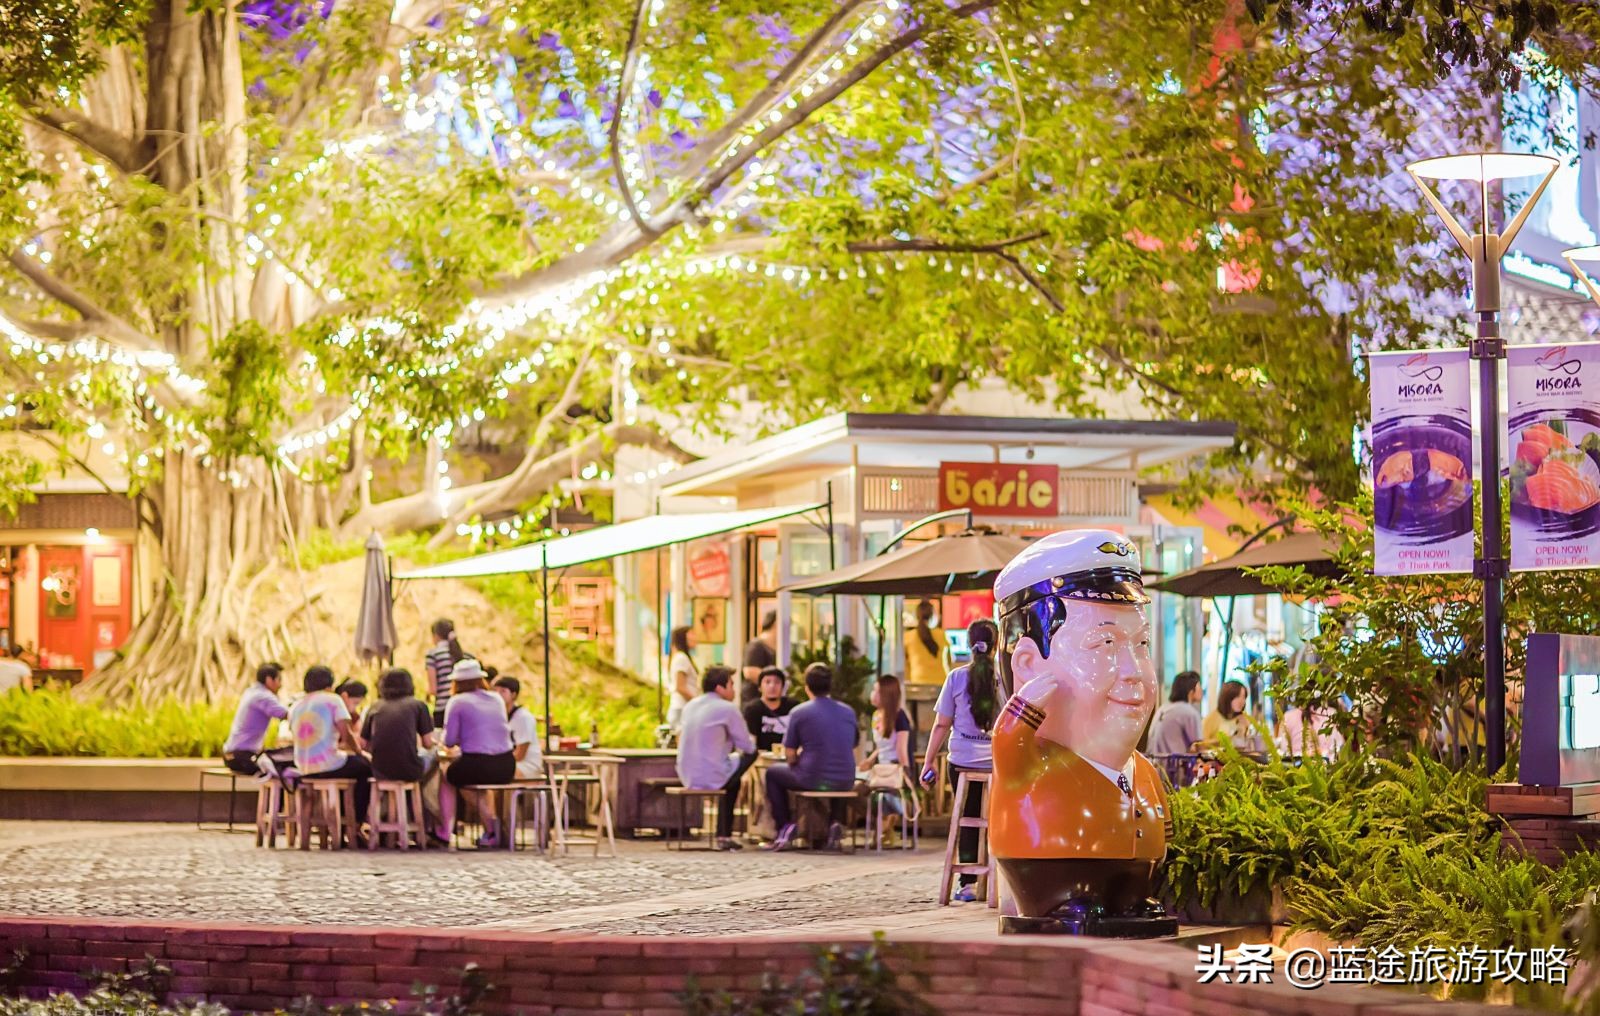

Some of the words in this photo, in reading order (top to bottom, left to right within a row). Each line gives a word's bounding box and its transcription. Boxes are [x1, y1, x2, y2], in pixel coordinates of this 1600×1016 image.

[1536, 377, 1582, 391] MISORA
[1398, 383, 1443, 397] MISORA
[945, 468, 1053, 508] basic
[1398, 550, 1421, 559] OPEN
[1535, 546, 1558, 555] OPEN
[1409, 561, 1430, 570] Think
[1433, 561, 1451, 569] Park
[1547, 557, 1568, 566] Think
[1572, 556, 1589, 565] Park
